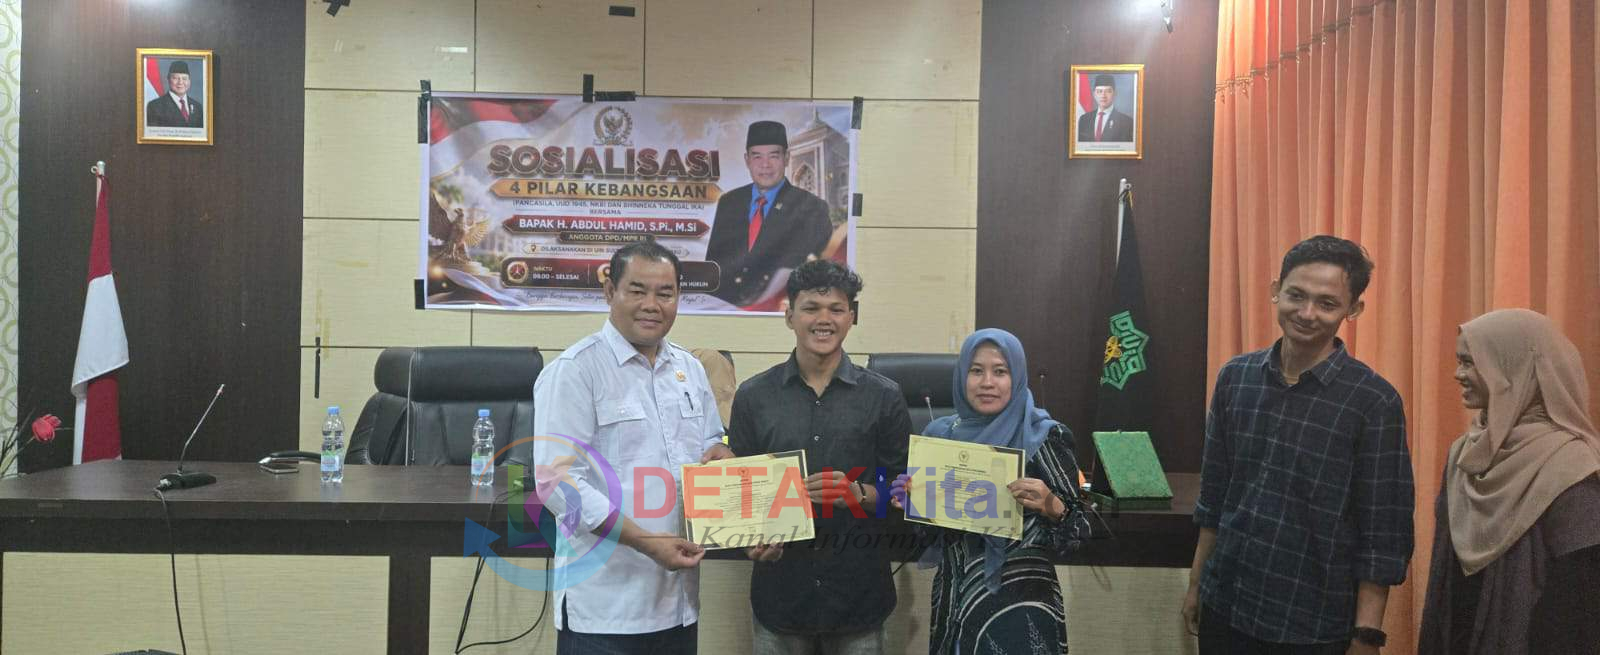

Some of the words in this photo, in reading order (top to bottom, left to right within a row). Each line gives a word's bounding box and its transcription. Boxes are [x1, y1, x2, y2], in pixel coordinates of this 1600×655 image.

[488, 145, 720, 179] SOSIALISASI
[510, 182, 520, 194] 4
[527, 182, 578, 195] PILAR
[585, 183, 707, 198] KEBANGSAAN
[659, 202, 689, 210] TUNGGAL
[519, 219, 554, 228] BAPAK
[557, 219, 568, 229] H.
[570, 220, 607, 230] ABDUL
[609, 221, 647, 232] HAMID,
[649, 222, 673, 232] S.Pi.,
[675, 222, 697, 232] M.Si
